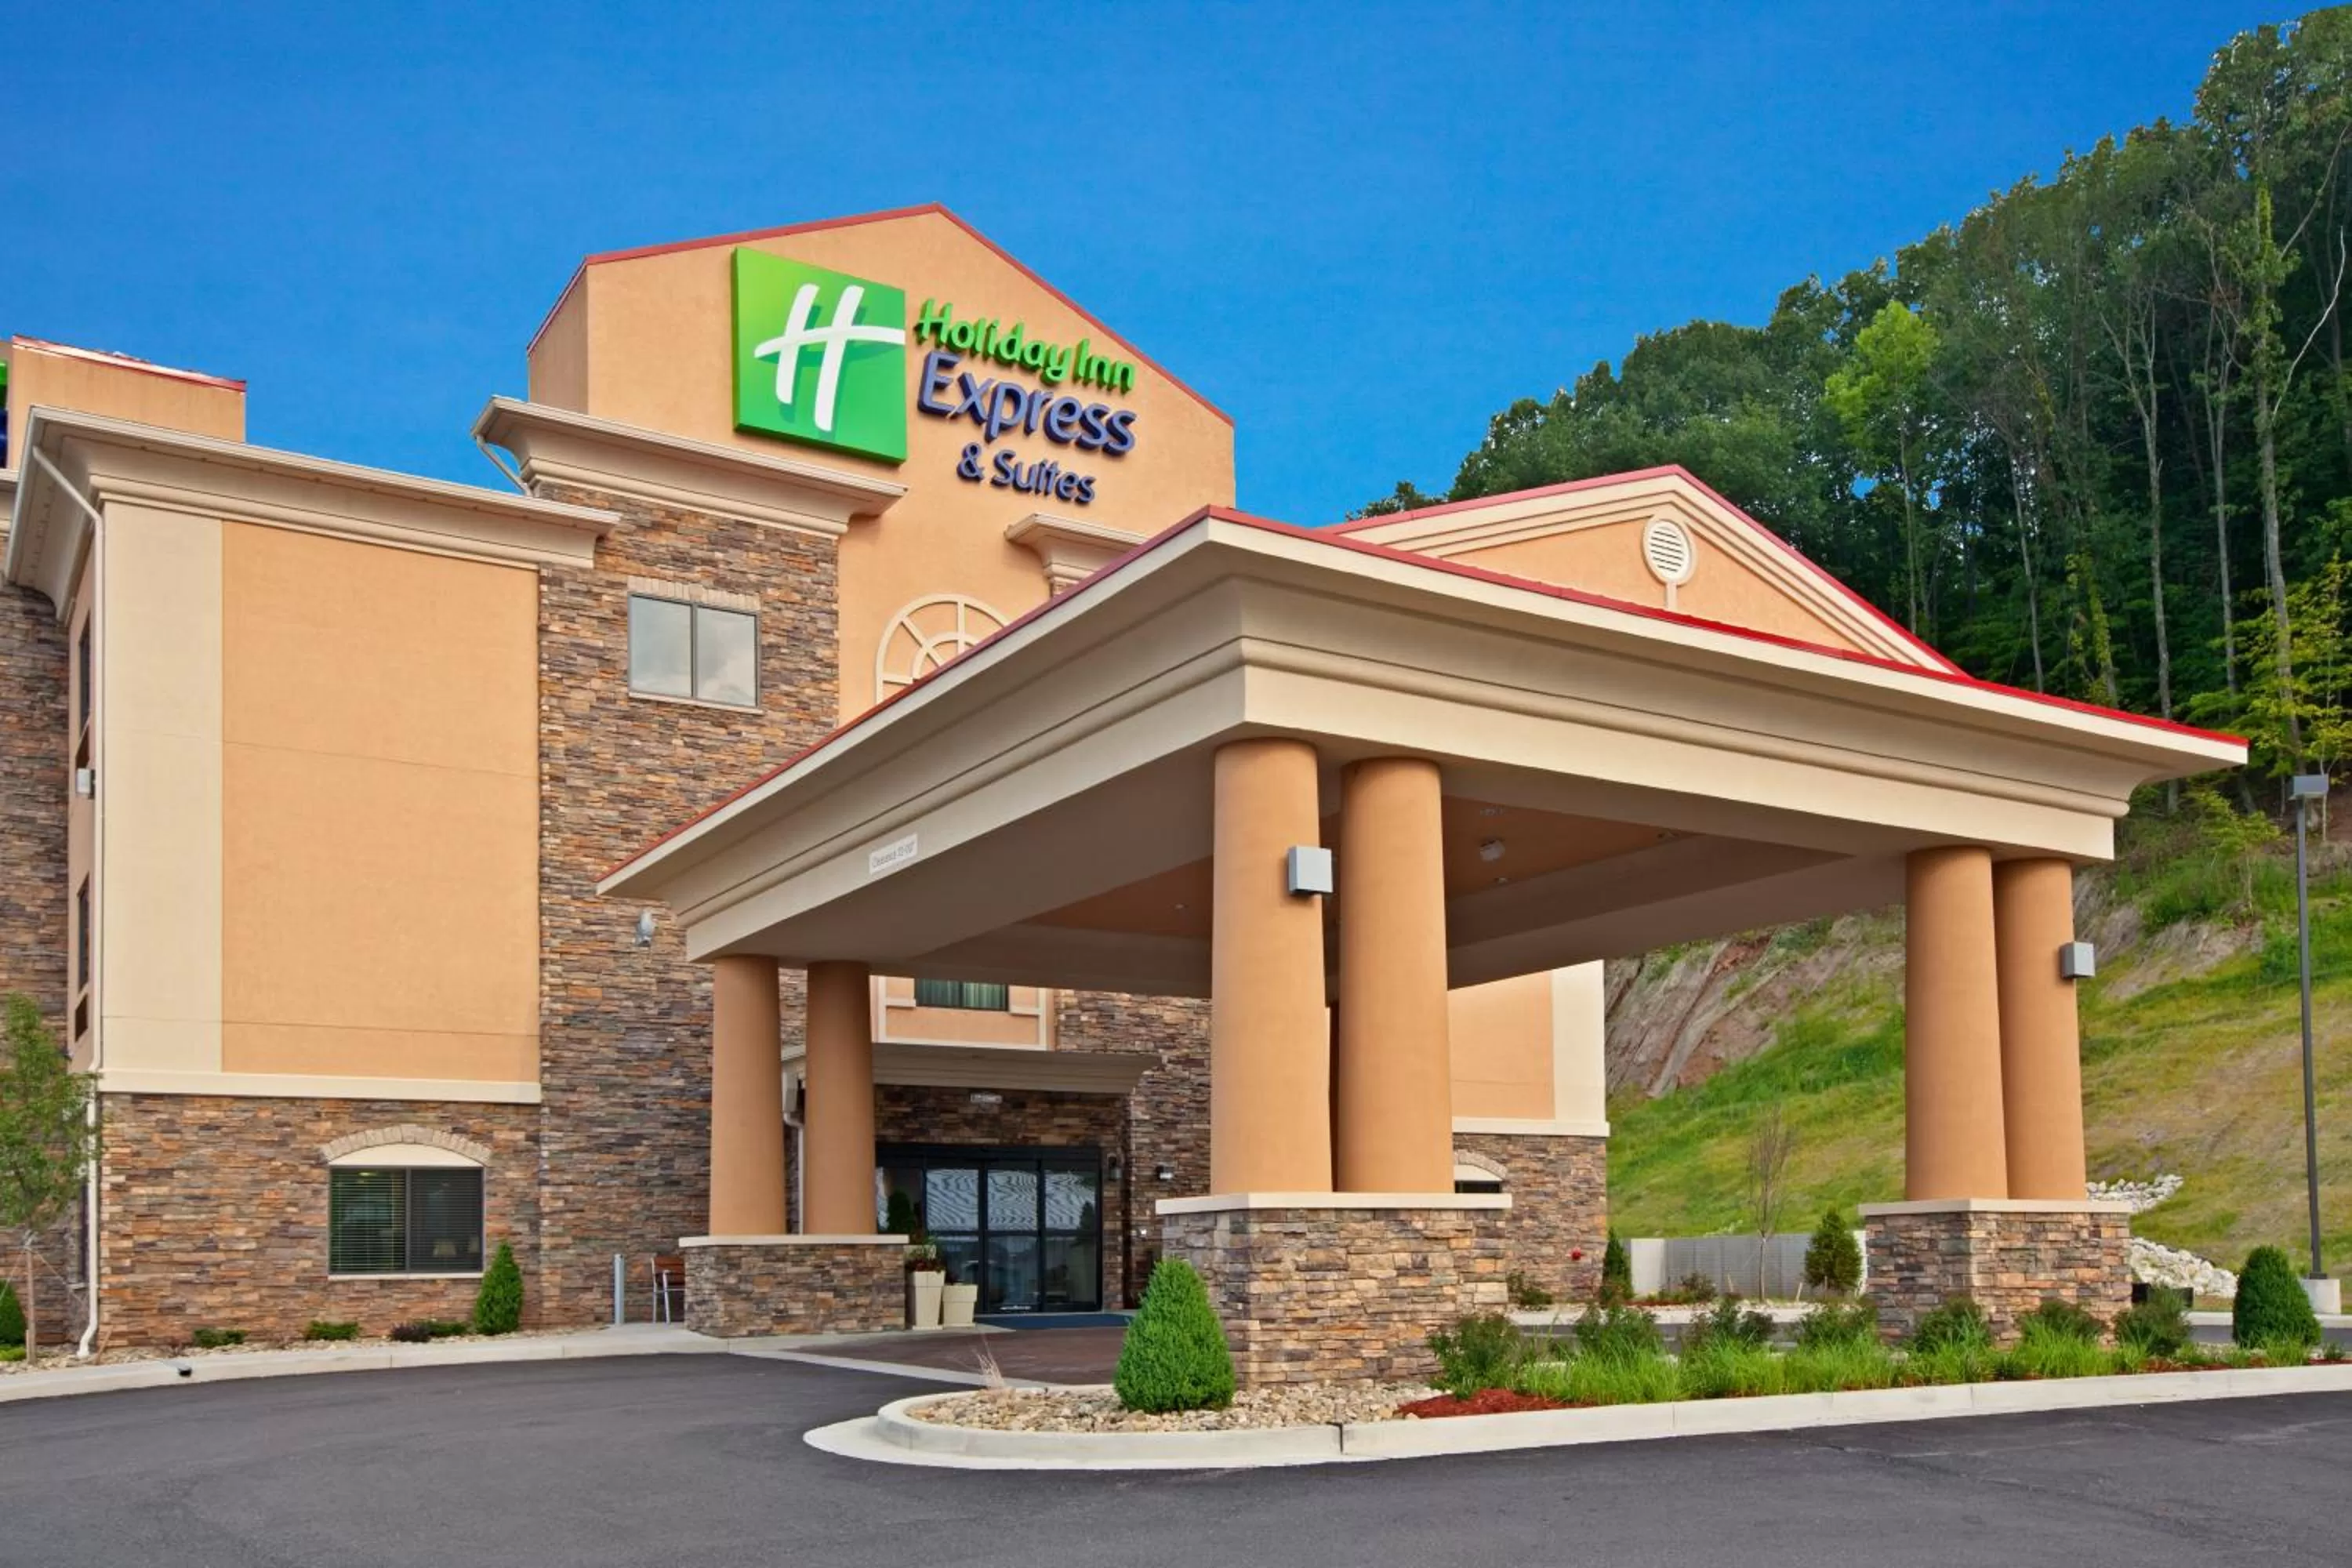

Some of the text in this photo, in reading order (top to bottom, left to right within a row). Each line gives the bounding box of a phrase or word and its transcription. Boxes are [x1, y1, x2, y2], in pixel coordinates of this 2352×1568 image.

[916, 299, 1135, 391] Holiday Inn
[918, 351, 1137, 455] Express
[958, 443, 1095, 503] & Suites
